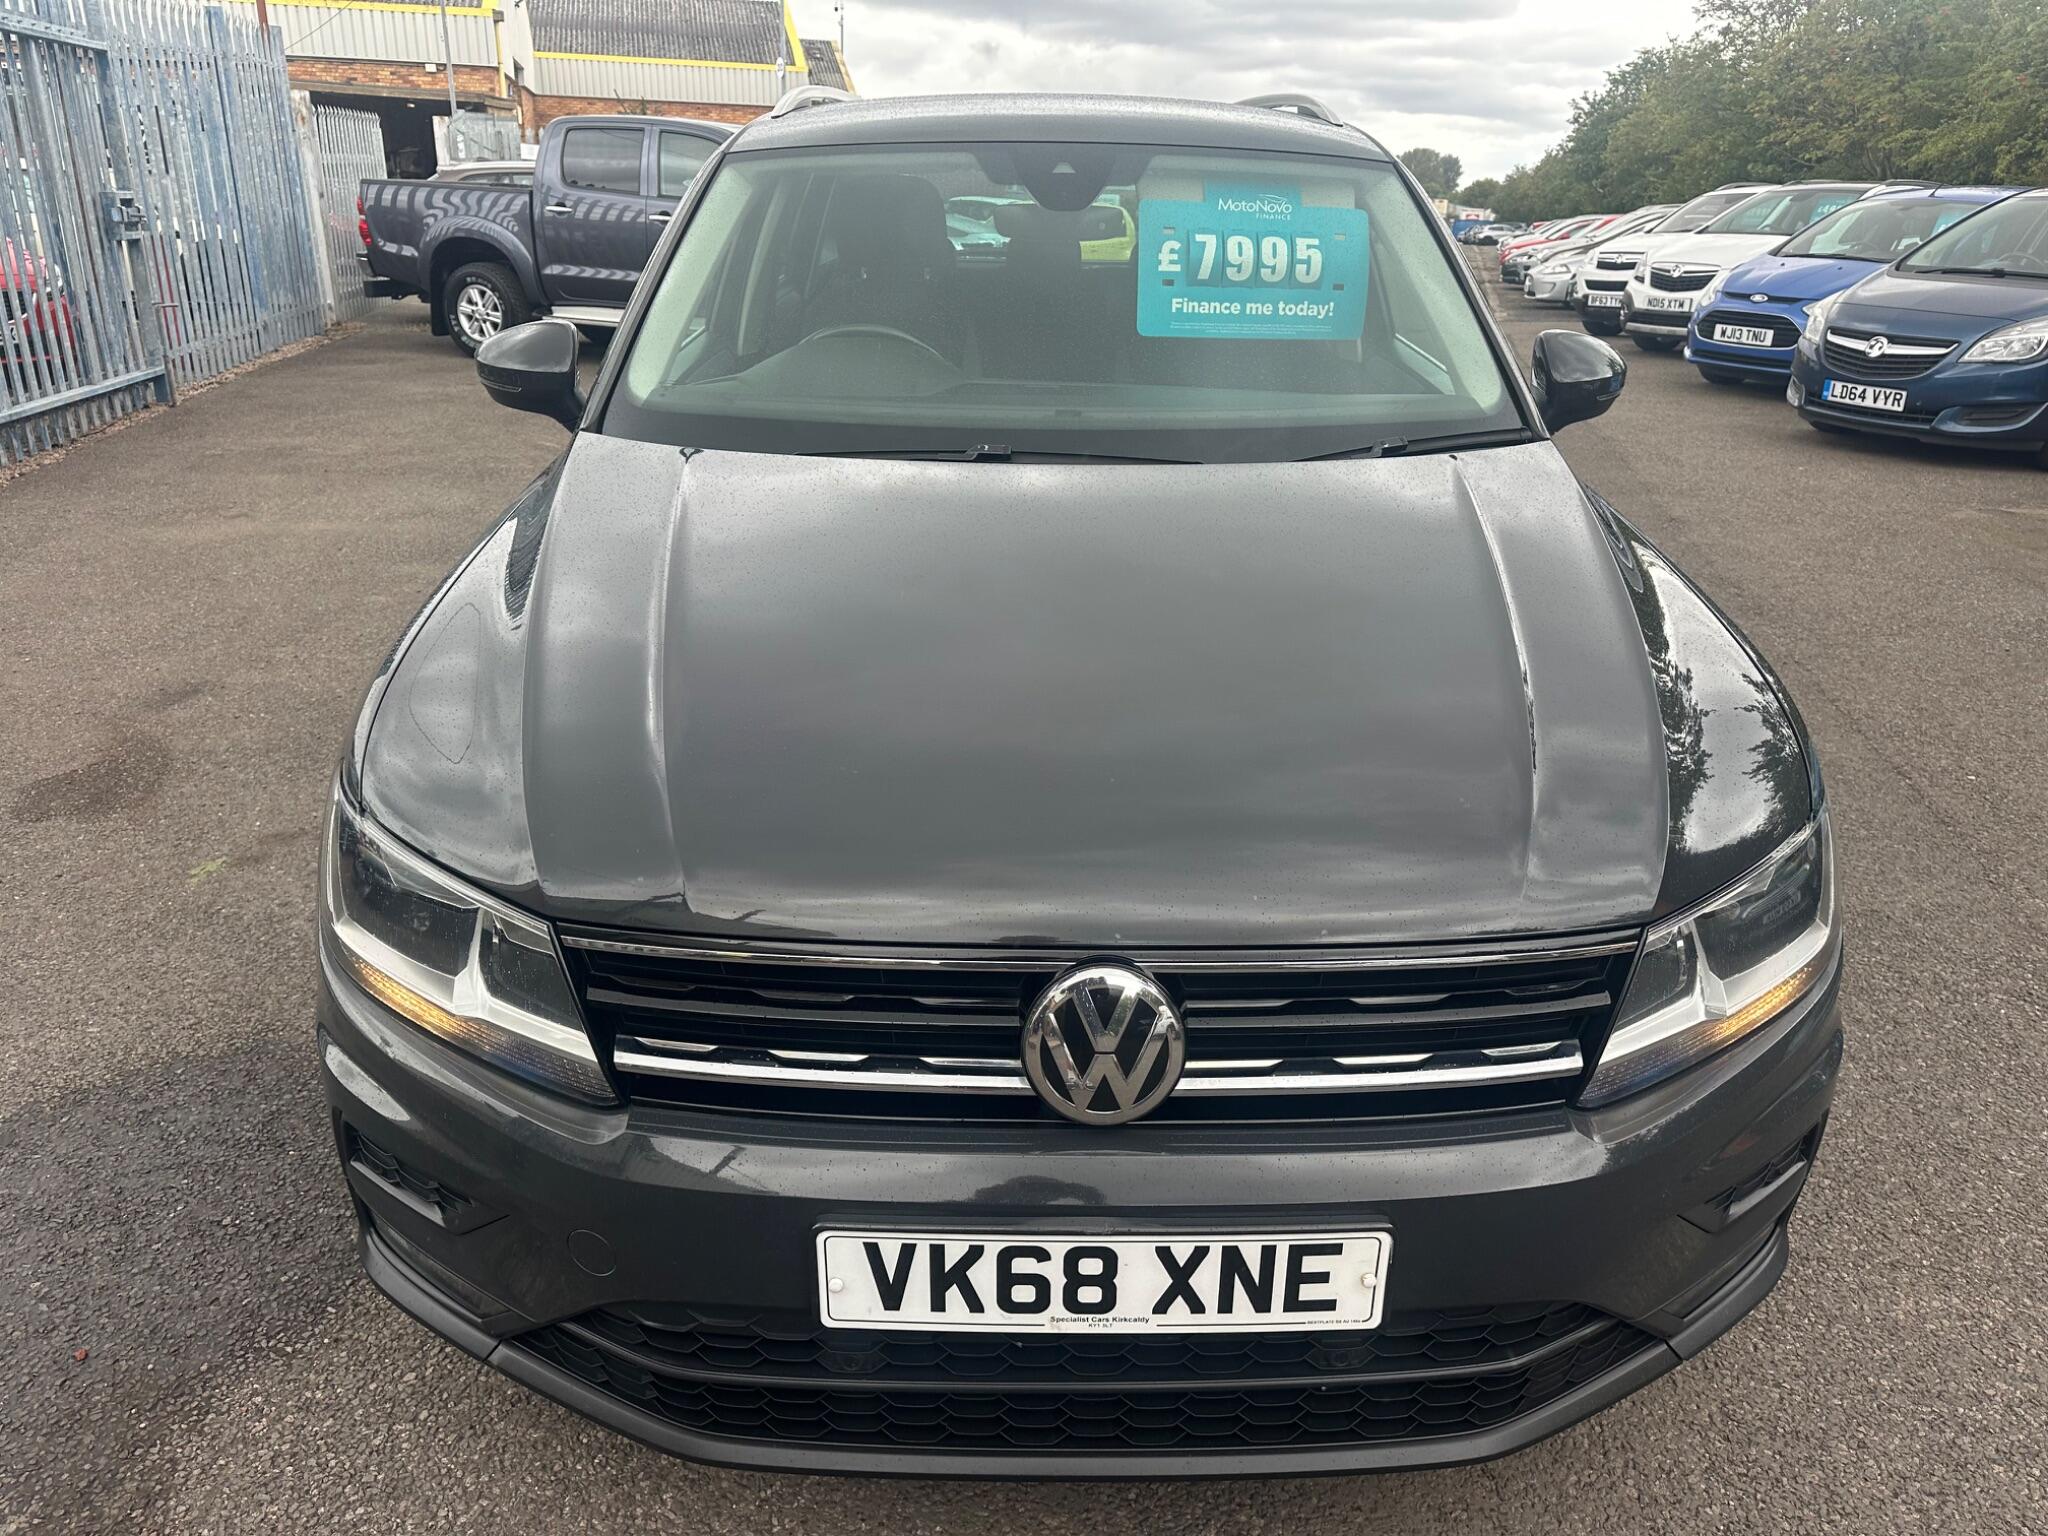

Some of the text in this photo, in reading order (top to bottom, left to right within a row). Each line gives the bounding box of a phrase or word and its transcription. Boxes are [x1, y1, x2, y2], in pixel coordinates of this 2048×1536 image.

[1217, 197, 1293, 213] MotoNovo
[1256, 213, 1290, 221] FINANCE
[1171, 298, 1335, 319] Finance me today!
[1647, 297, 1685, 310] ND15 XTM
[1720, 326, 1767, 343] WJ13 TNU
[1830, 383, 1904, 407] LD64 VYR
[862, 1241, 1344, 1315] VK68 XNE
[1050, 1316, 1089, 1324] Specialist
[1112, 1316, 1150, 1324] Kirkcaldy
